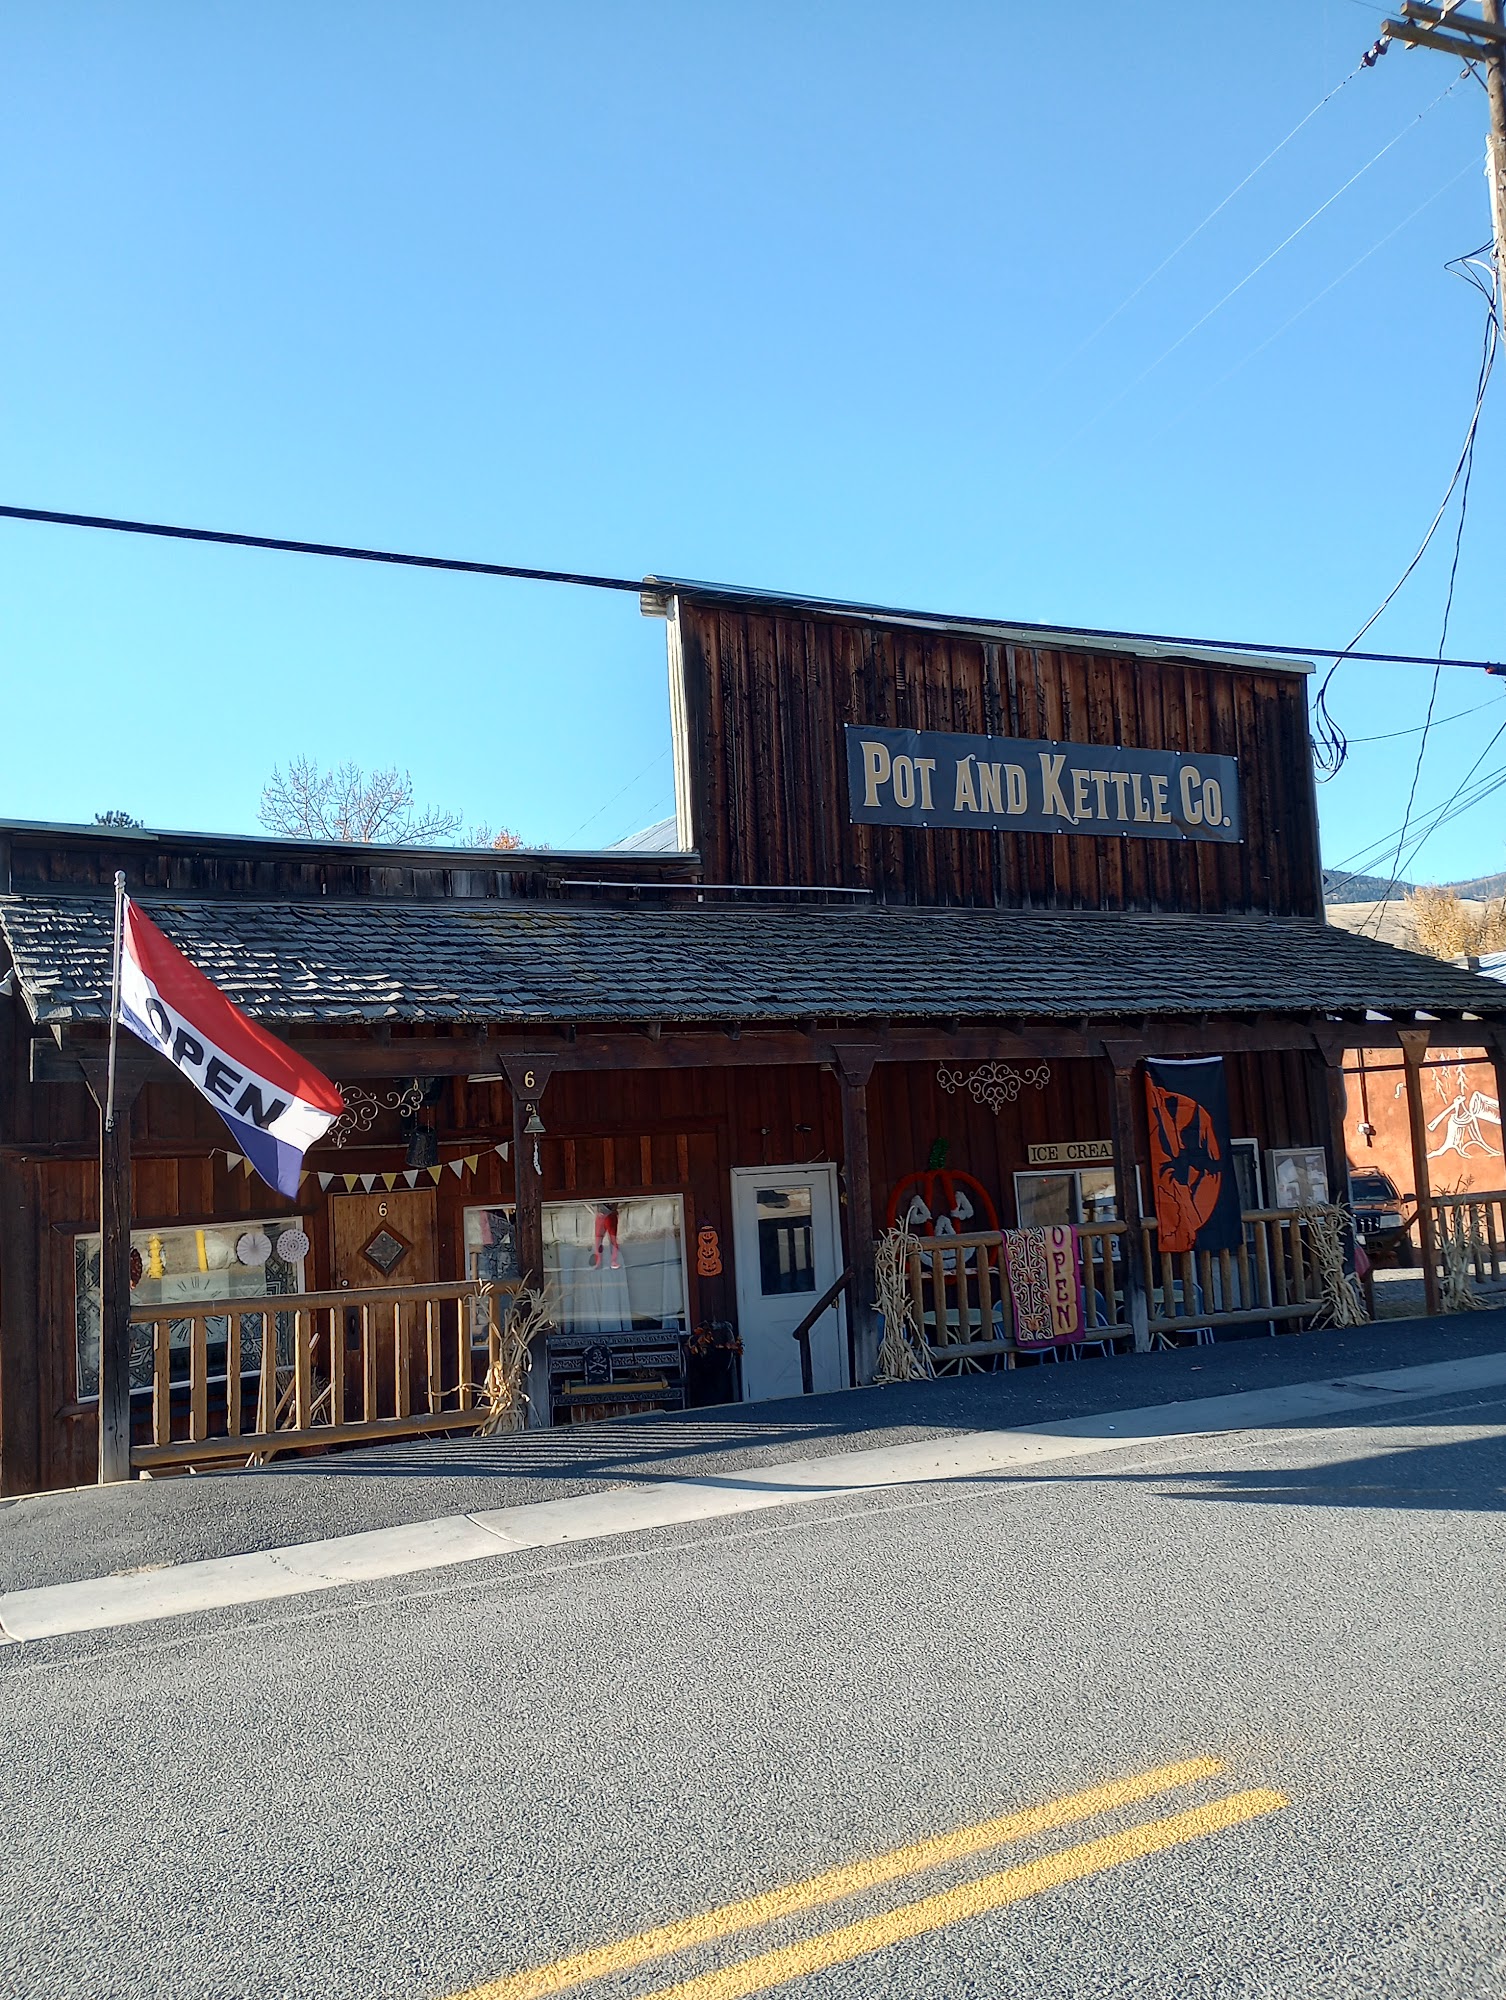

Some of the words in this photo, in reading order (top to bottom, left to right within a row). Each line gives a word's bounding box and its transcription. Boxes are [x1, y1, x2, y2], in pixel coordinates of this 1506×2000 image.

[859, 740, 937, 811] POT
[953, 753, 1028, 816] AND
[1037, 752, 1173, 826] KETTLE
[1178, 764, 1232, 828] CO.
[145, 997, 287, 1132] OPEN
[523, 1070, 536, 1089] 6
[1031, 1145, 1059, 1162] ICE
[1066, 1142, 1114, 1160] CREA
[378, 1202, 388, 1217] 6
[1052, 1226, 1071, 1330] OPEN
